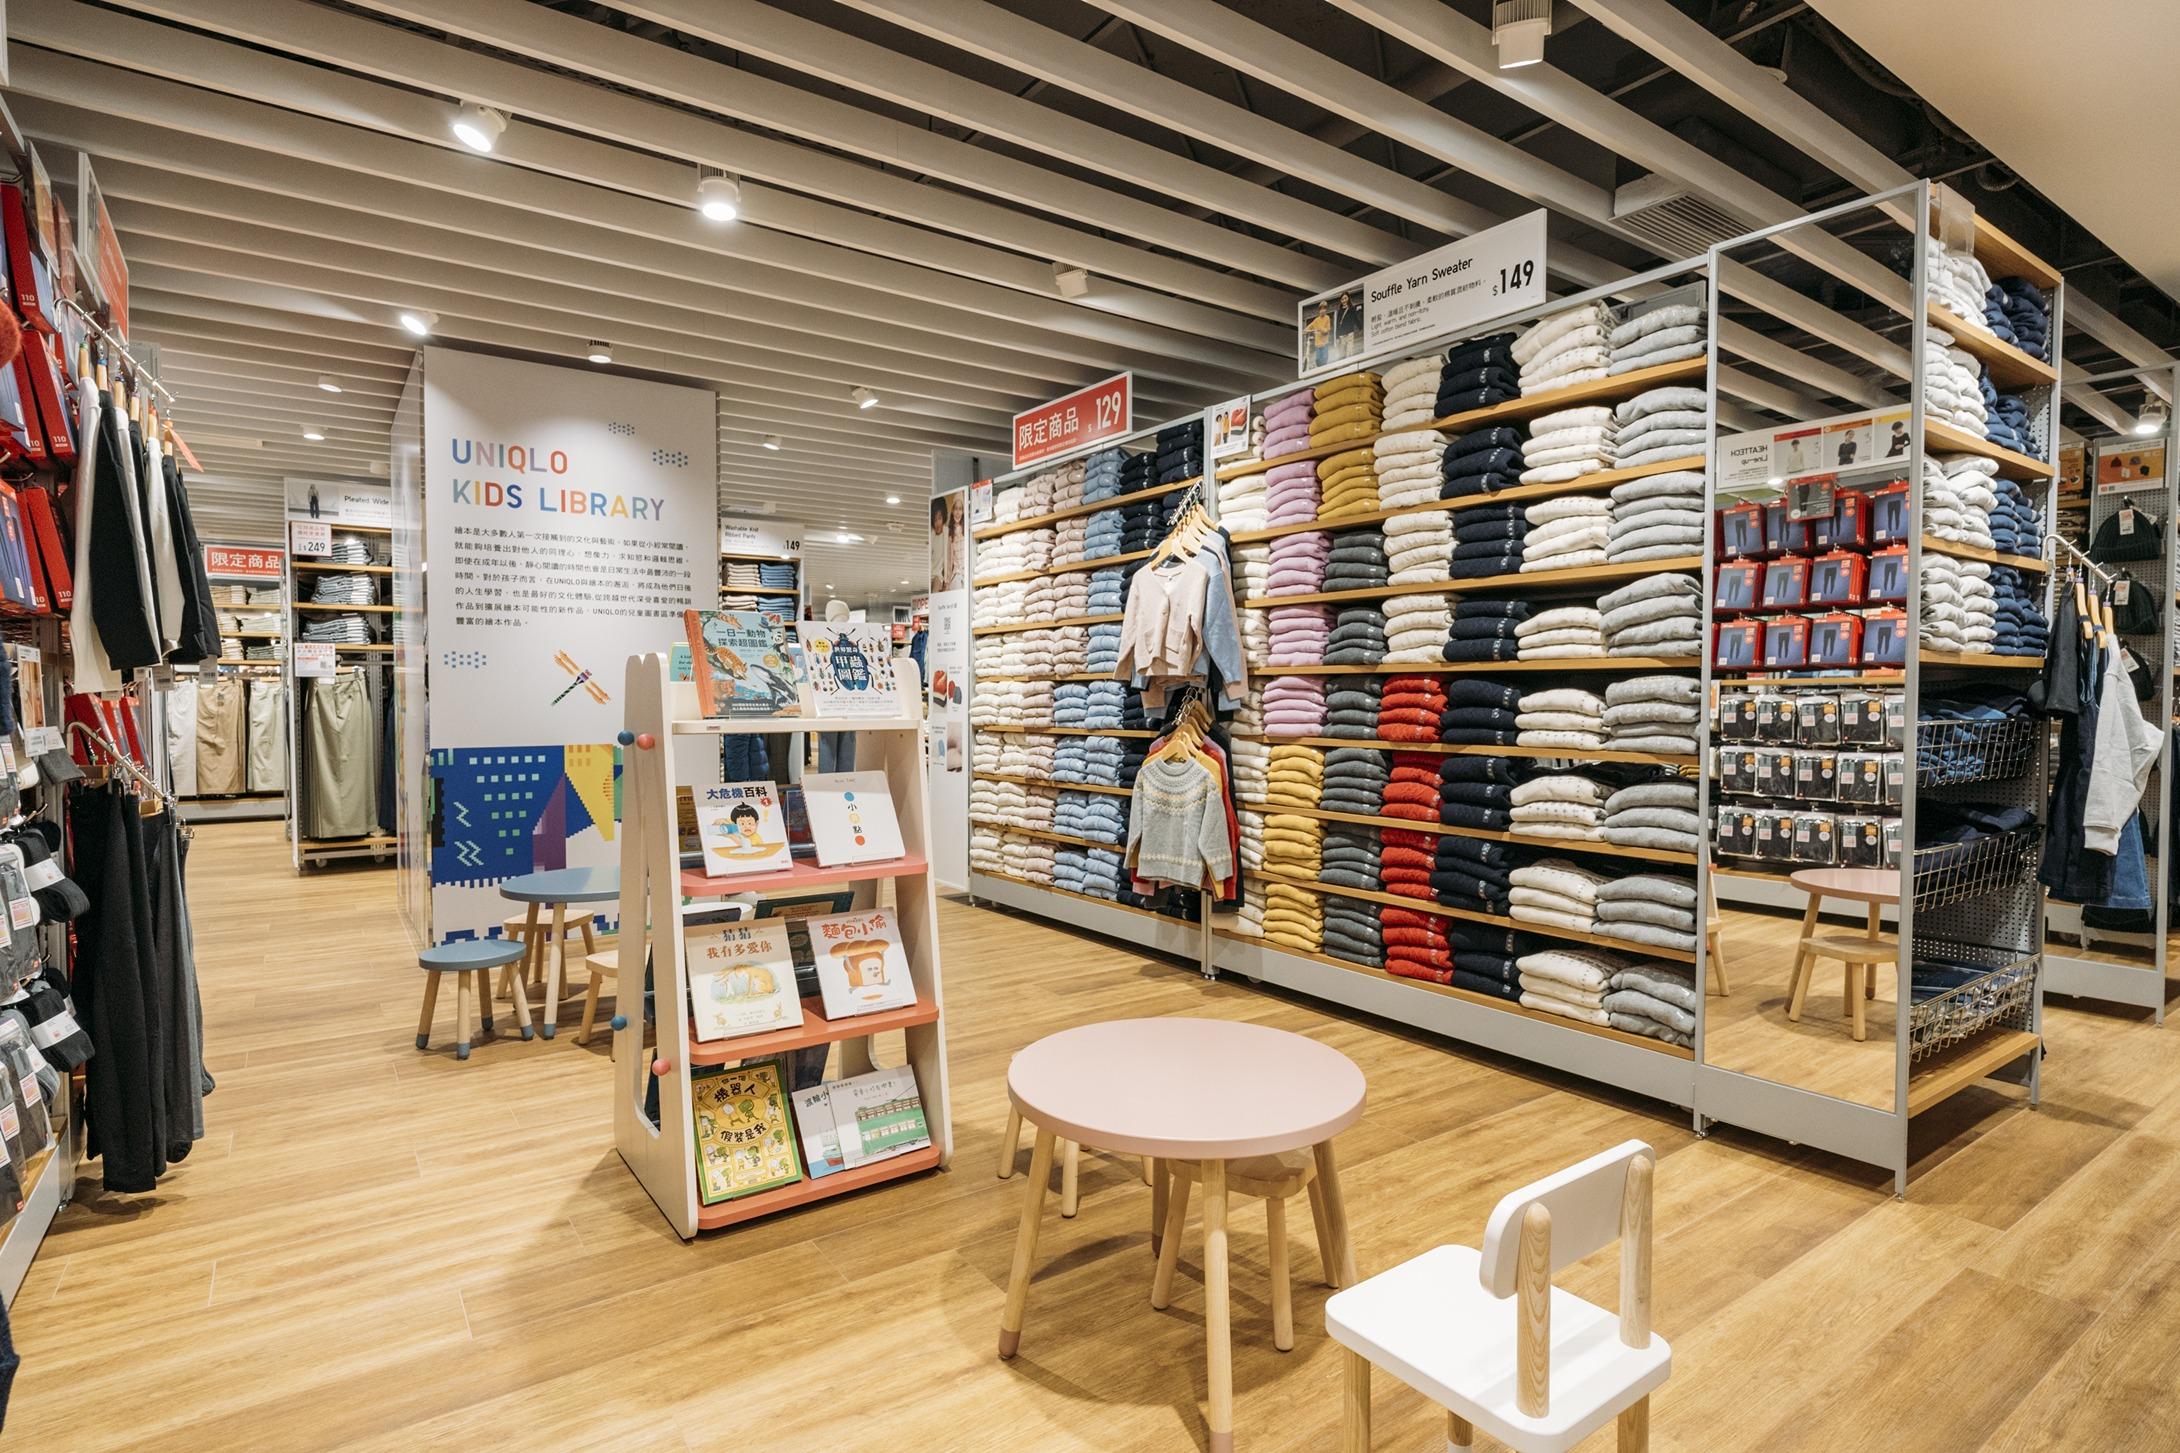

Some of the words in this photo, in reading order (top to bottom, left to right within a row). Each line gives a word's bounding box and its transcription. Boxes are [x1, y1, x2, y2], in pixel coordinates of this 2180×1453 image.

[1371, 283, 1402, 303] Souffle
[1406, 274, 1428, 290] Yarn
[1432, 258, 1473, 281] Sweater
[21, 294, 35, 302] 110
[1019, 407, 1079, 451] 限定商品
[53, 435, 67, 443] 110
[451, 438, 569, 475] UNIQLO
[452, 478, 523, 509] KIDS
[539, 487, 665, 521] LIBRARY
[211, 551, 281, 569] 限定商品
[58, 590, 72, 598] 110
[716, 628, 766, 638] 一日一動物
[706, 786, 767, 800] 大危機百科
[847, 802, 858, 812] 小
[722, 926, 752, 942] 猜猜
[821, 914, 887, 939] 麵包小偷
[706, 940, 773, 959] 我有多愛你
[714, 1082, 756, 1103] 機器人
[720, 1122, 767, 1143] 假裝是我
